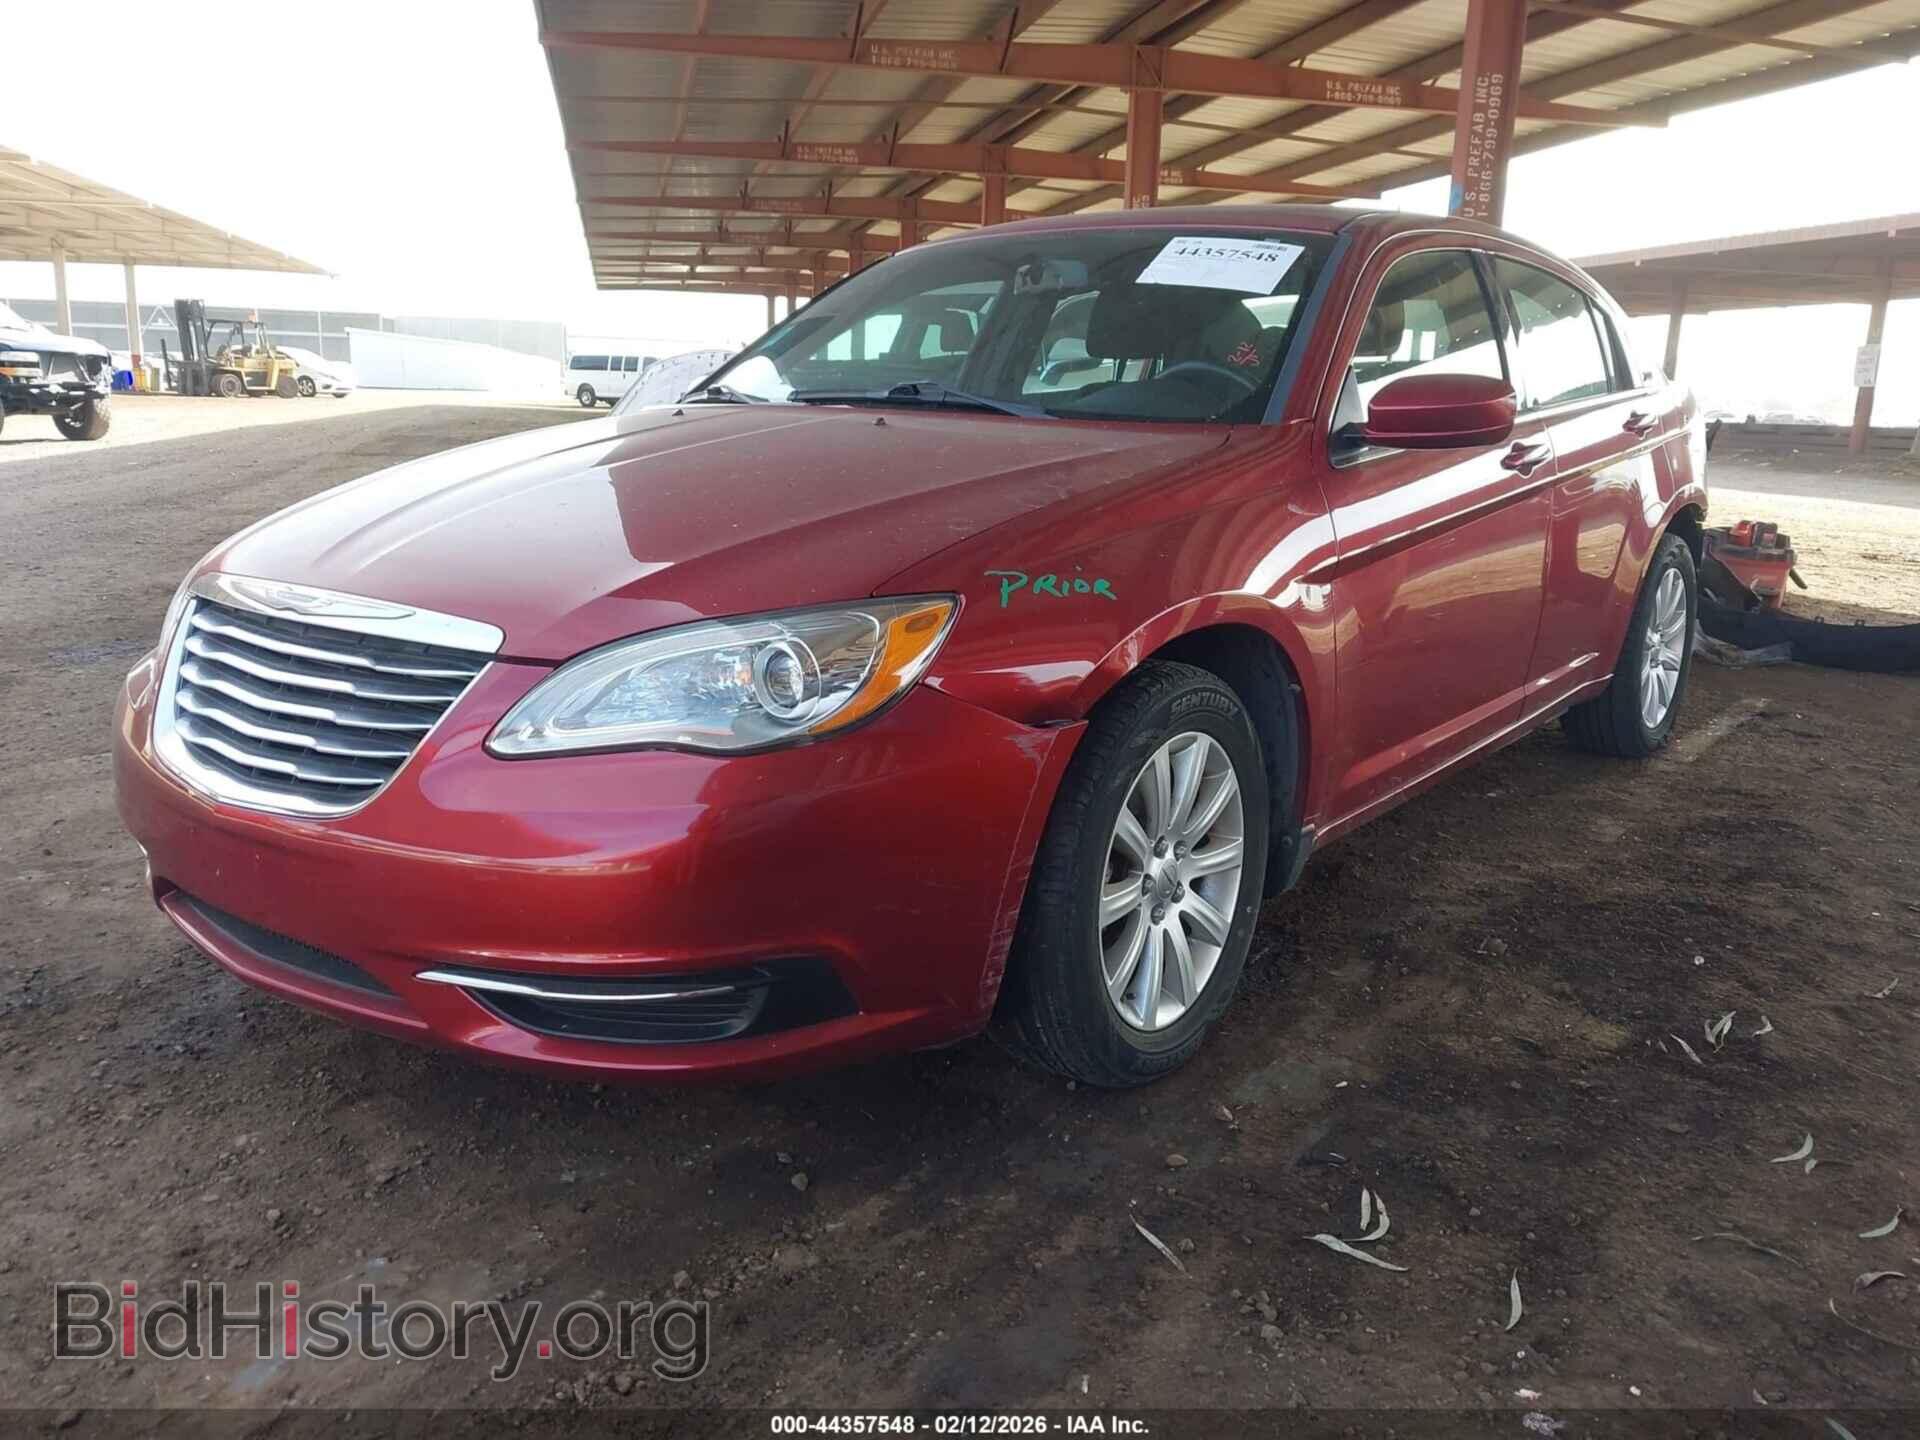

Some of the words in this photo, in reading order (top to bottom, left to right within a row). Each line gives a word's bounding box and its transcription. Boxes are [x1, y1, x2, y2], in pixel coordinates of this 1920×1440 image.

[1475, 72, 1489, 103] INC.
[1467, 112, 1485, 177] PREFAB
[1477, 74, 1504, 216] 1-866-799-0969
[1463, 187, 1477, 217] U.S.
[1175, 247, 1279, 262] 44357548
